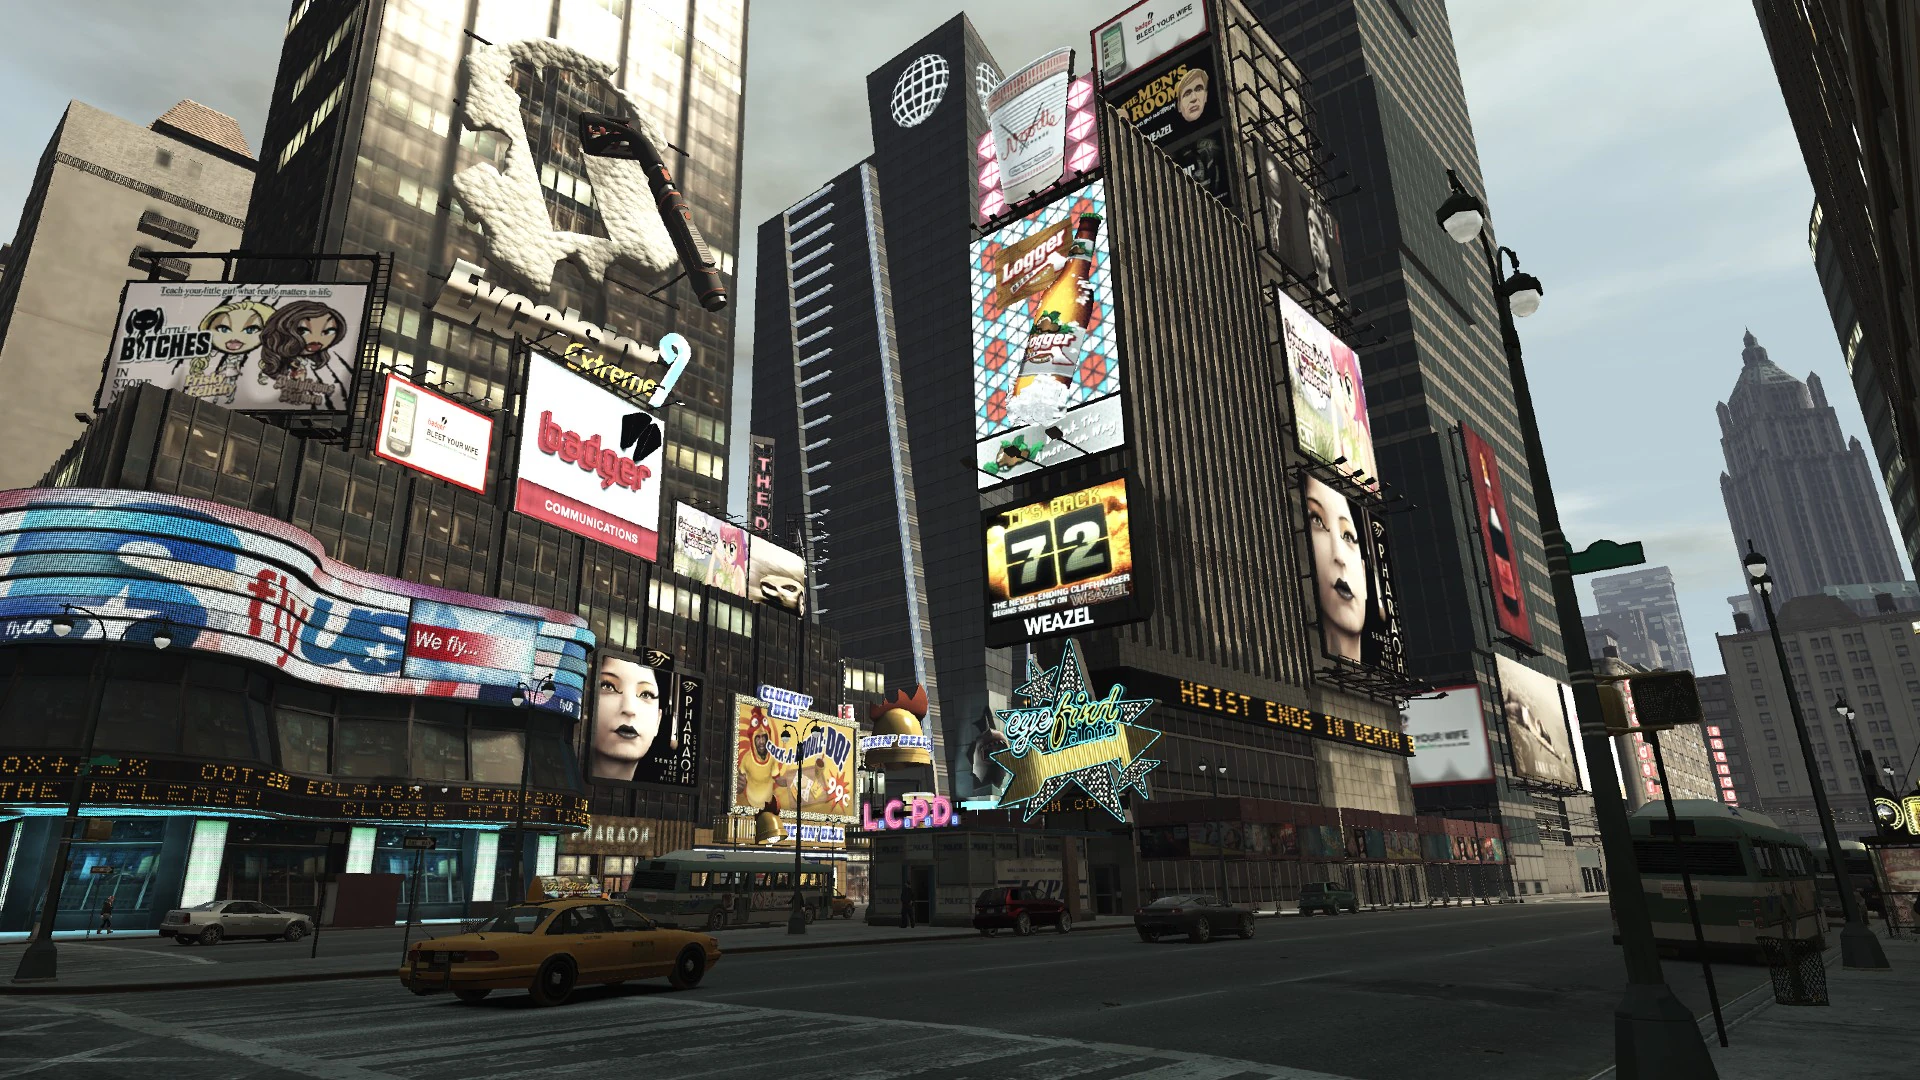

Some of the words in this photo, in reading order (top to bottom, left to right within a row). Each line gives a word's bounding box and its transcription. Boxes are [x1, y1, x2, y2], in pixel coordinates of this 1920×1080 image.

[1136, 25, 1156, 41] BLEET
[1157, 13, 1175, 29] YOUR
[1176, 3, 1193, 17] WIFE
[1121, 95, 1138, 111] THE
[1138, 63, 1189, 103] MEN'S
[1001, 228, 1066, 285] Logger
[161, 287, 183, 296] Teach
[184, 288, 202, 298] your
[203, 286, 221, 295] little
[222, 286, 236, 298] girl
[257, 287, 278, 299] really
[279, 288, 307, 296] matters
[120, 332, 211, 361] BITCHES
[112, 378, 152, 388] STOR
[115, 368, 129, 378] IN
[186, 373, 225, 387] Frisky
[565, 343, 657, 397] Extreme
[648, 333, 691, 407] 9
[188, 383, 237, 397] Felicity
[426, 428, 447, 442] BLEET
[447, 437, 464, 449] YOUR
[464, 444, 479, 456] WIFE
[538, 410, 651, 491] badger
[756, 457, 771, 507] THE
[545, 499, 638, 544] COMMUNICATIONS
[1007, 506, 1043, 527] IT'S
[1050, 488, 1101, 516] BACK
[1011, 521, 1104, 585] 72
[992, 601, 1008, 611] THE
[1009, 587, 1069, 608] NEVER-ENDING
[1070, 574, 1130, 593] CLIFFHANGER
[992, 608, 1017, 618] BEGINS
[1018, 603, 1037, 612] SOON
[1038, 599, 1055, 608] ONLY
[1057, 596, 1067, 604] ON
[1070, 583, 1130, 606] WEAZEL
[1024, 606, 1094, 636] WEAZEL
[1377, 542, 1405, 674] PHARAOH
[415, 630, 443, 651] We
[446, 635, 479, 658] fly...
[1371, 631, 1391, 645] SENSE
[1381, 651, 1393, 662] THE
[762, 686, 813, 709] CLUCKIN'
[773, 702, 799, 720] BELL
[1180, 679, 1251, 717] HEIST
[1265, 700, 1313, 731] ENDS
[1325, 715, 1346, 737] IN
[1353, 722, 1400, 750] DEATH
[680, 695, 693, 784] PHARAOH
[899, 735, 928, 747] BELL
[0, 781, 62, 799] THE
[342, 801, 447, 818] CLOSES
